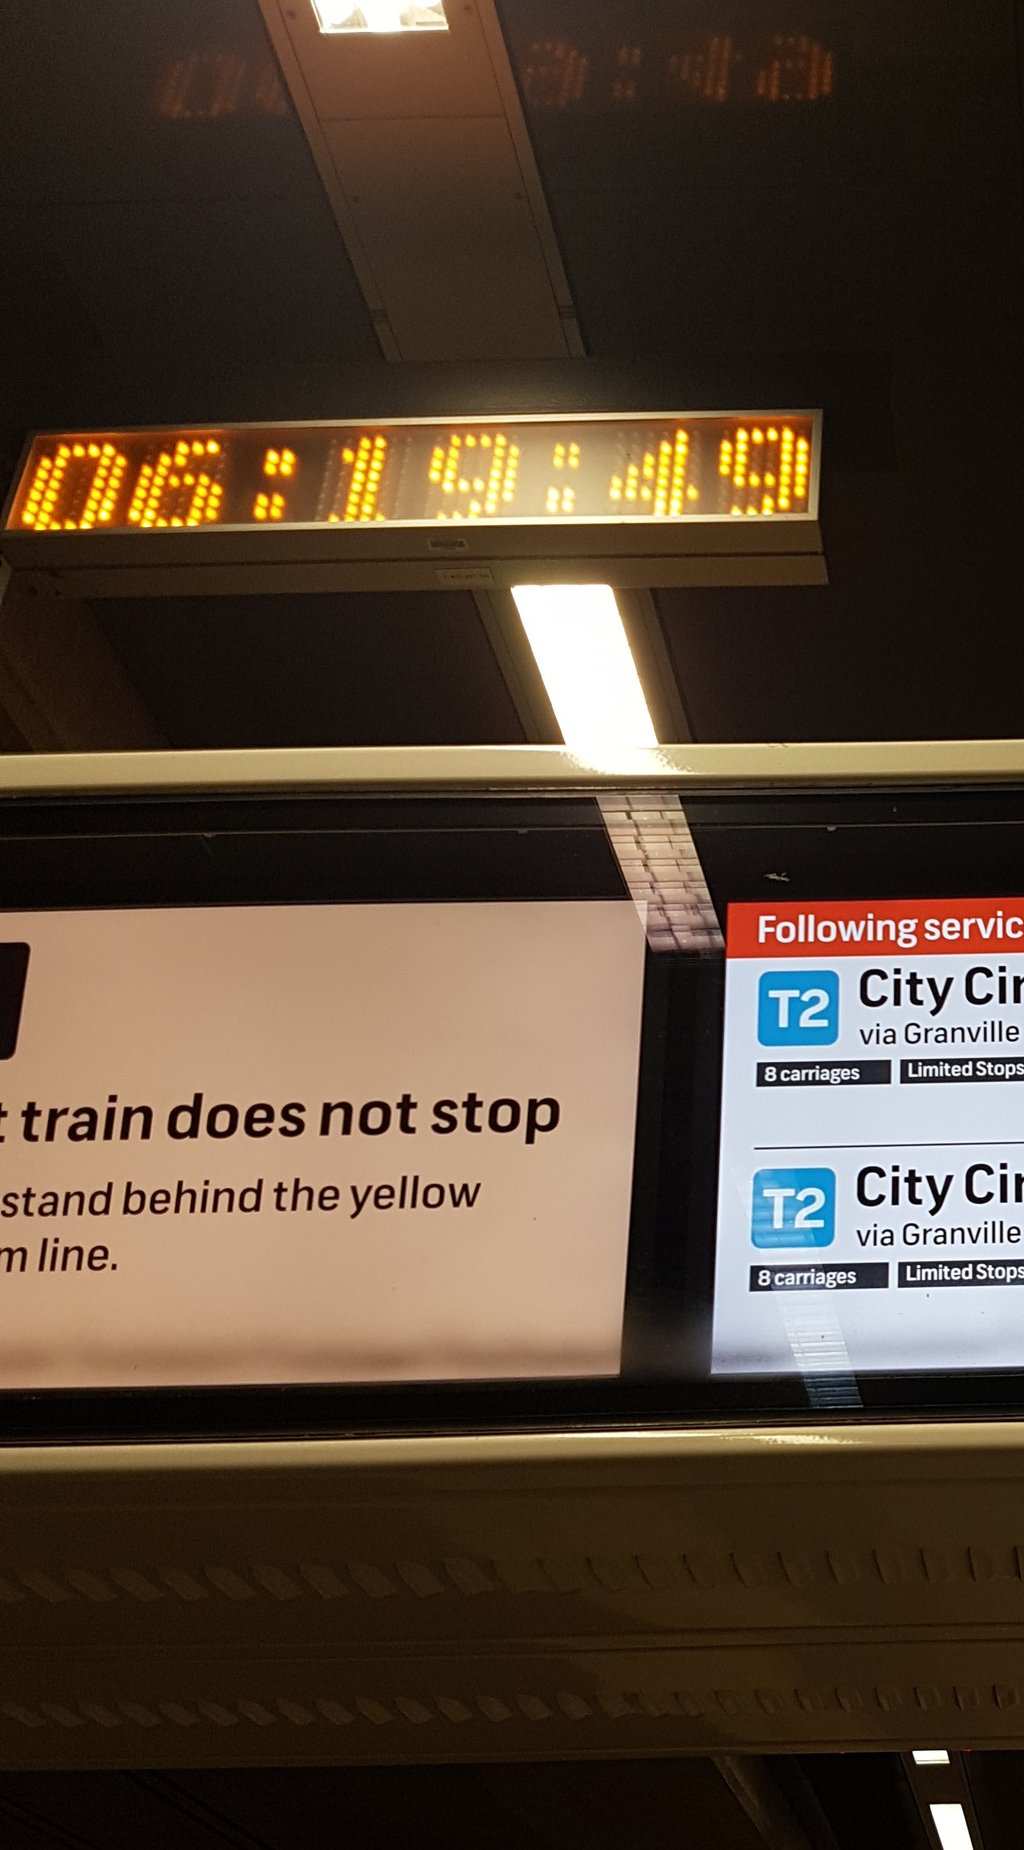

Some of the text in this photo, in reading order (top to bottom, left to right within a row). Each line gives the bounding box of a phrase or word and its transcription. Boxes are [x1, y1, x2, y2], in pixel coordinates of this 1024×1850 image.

[20, 426, 809, 531] 06:19:49
[758, 912, 919, 949] Following
[768, 988, 830, 1028] T2
[859, 967, 955, 1017] City
[859, 1020, 1020, 1045] via Granville
[764, 1065, 860, 1085] 8 carriages
[908, 1060, 973, 1078] Limited
[20, 1094, 154, 1143] train
[167, 1092, 307, 1140] does
[319, 1093, 418, 1137] not
[430, 1092, 560, 1145] stop
[0, 1175, 482, 1220] stand behind the yellow
[762, 1185, 826, 1230] T2
[856, 1164, 954, 1217] City
[856, 1220, 1021, 1247] via Granville
[38, 1237, 117, 1272] line.
[906, 1263, 973, 1282] Limited
[757, 1268, 857, 1289] 8 carriages
